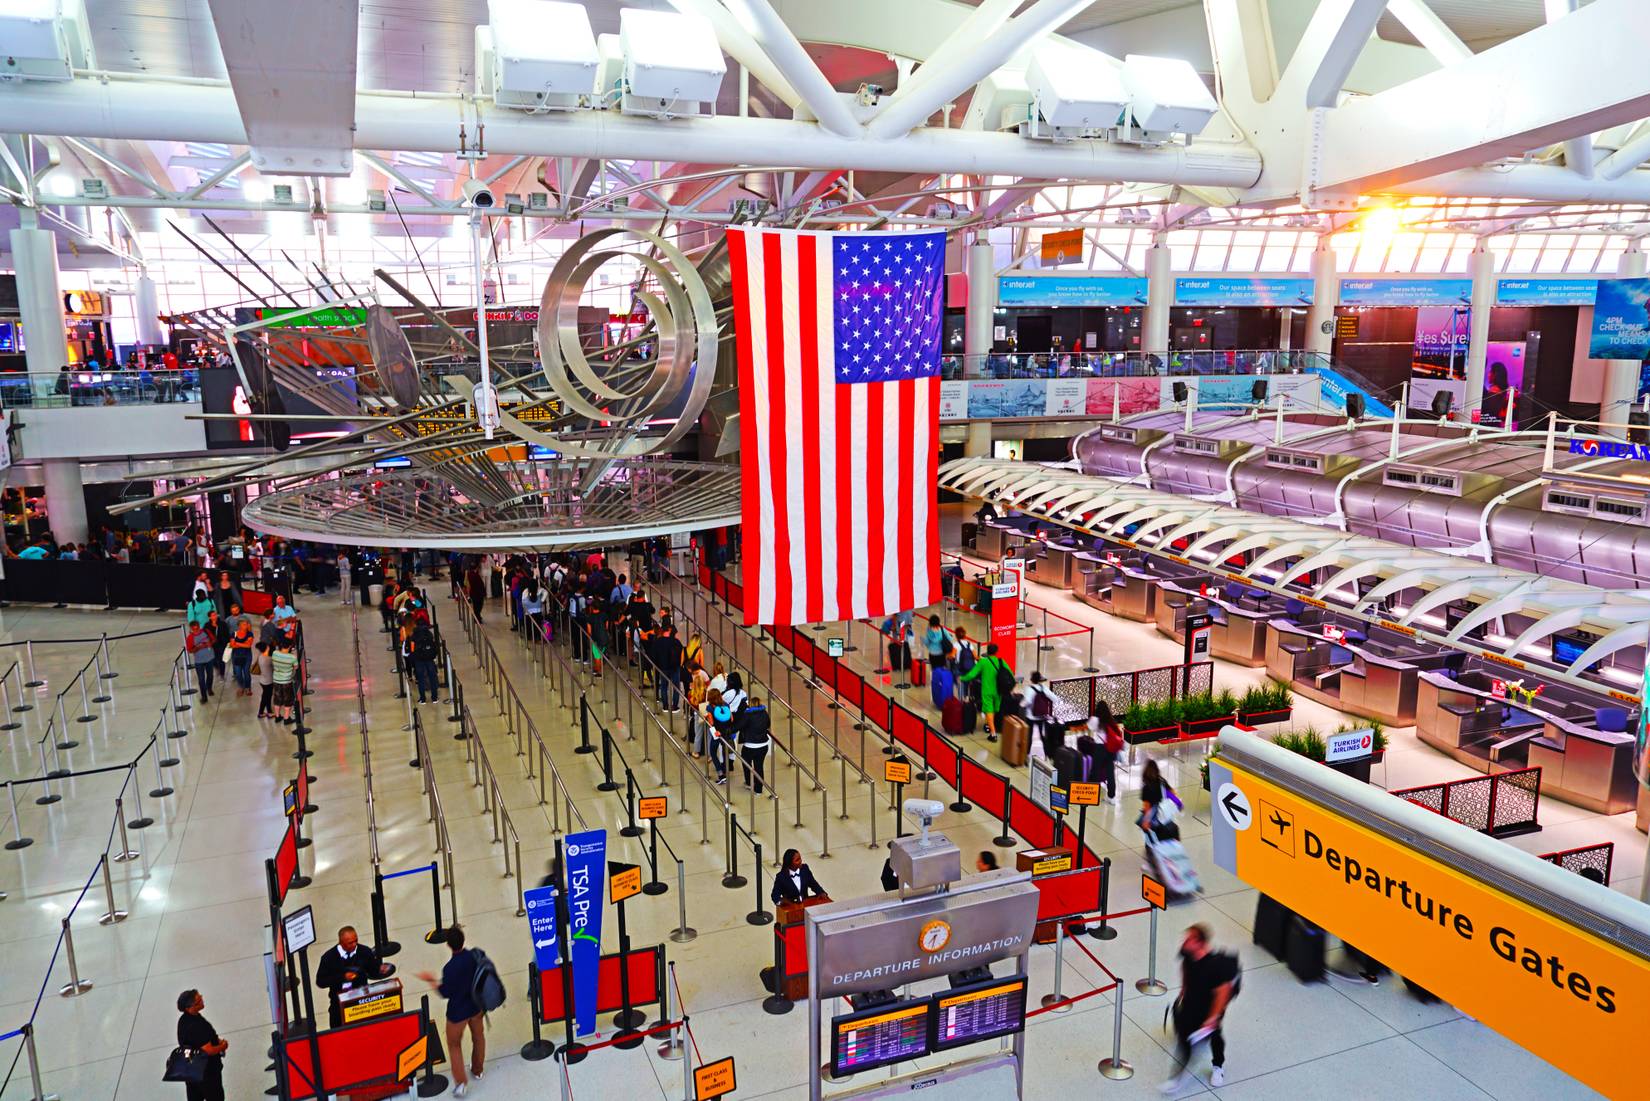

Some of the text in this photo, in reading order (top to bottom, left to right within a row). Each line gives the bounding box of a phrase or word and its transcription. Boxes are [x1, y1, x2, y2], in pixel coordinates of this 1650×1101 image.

[1610, 337, 1649, 345] TO CHECK
[1333, 738, 1361, 747] TURKISH
[1333, 744, 1360, 753] AIRLINES
[572, 865, 589, 898] TSA
[532, 916, 553, 926] Enter
[1304, 828, 1617, 1014] Departure Gates
[533, 924, 553, 933] Here
[833, 935, 1024, 985] DEPARTURE INFORMATION
[358, 995, 385, 1004] SECURITY
[702, 1068, 728, 1080] FIRST CLASS
[705, 1080, 726, 1091] BUSINESS
